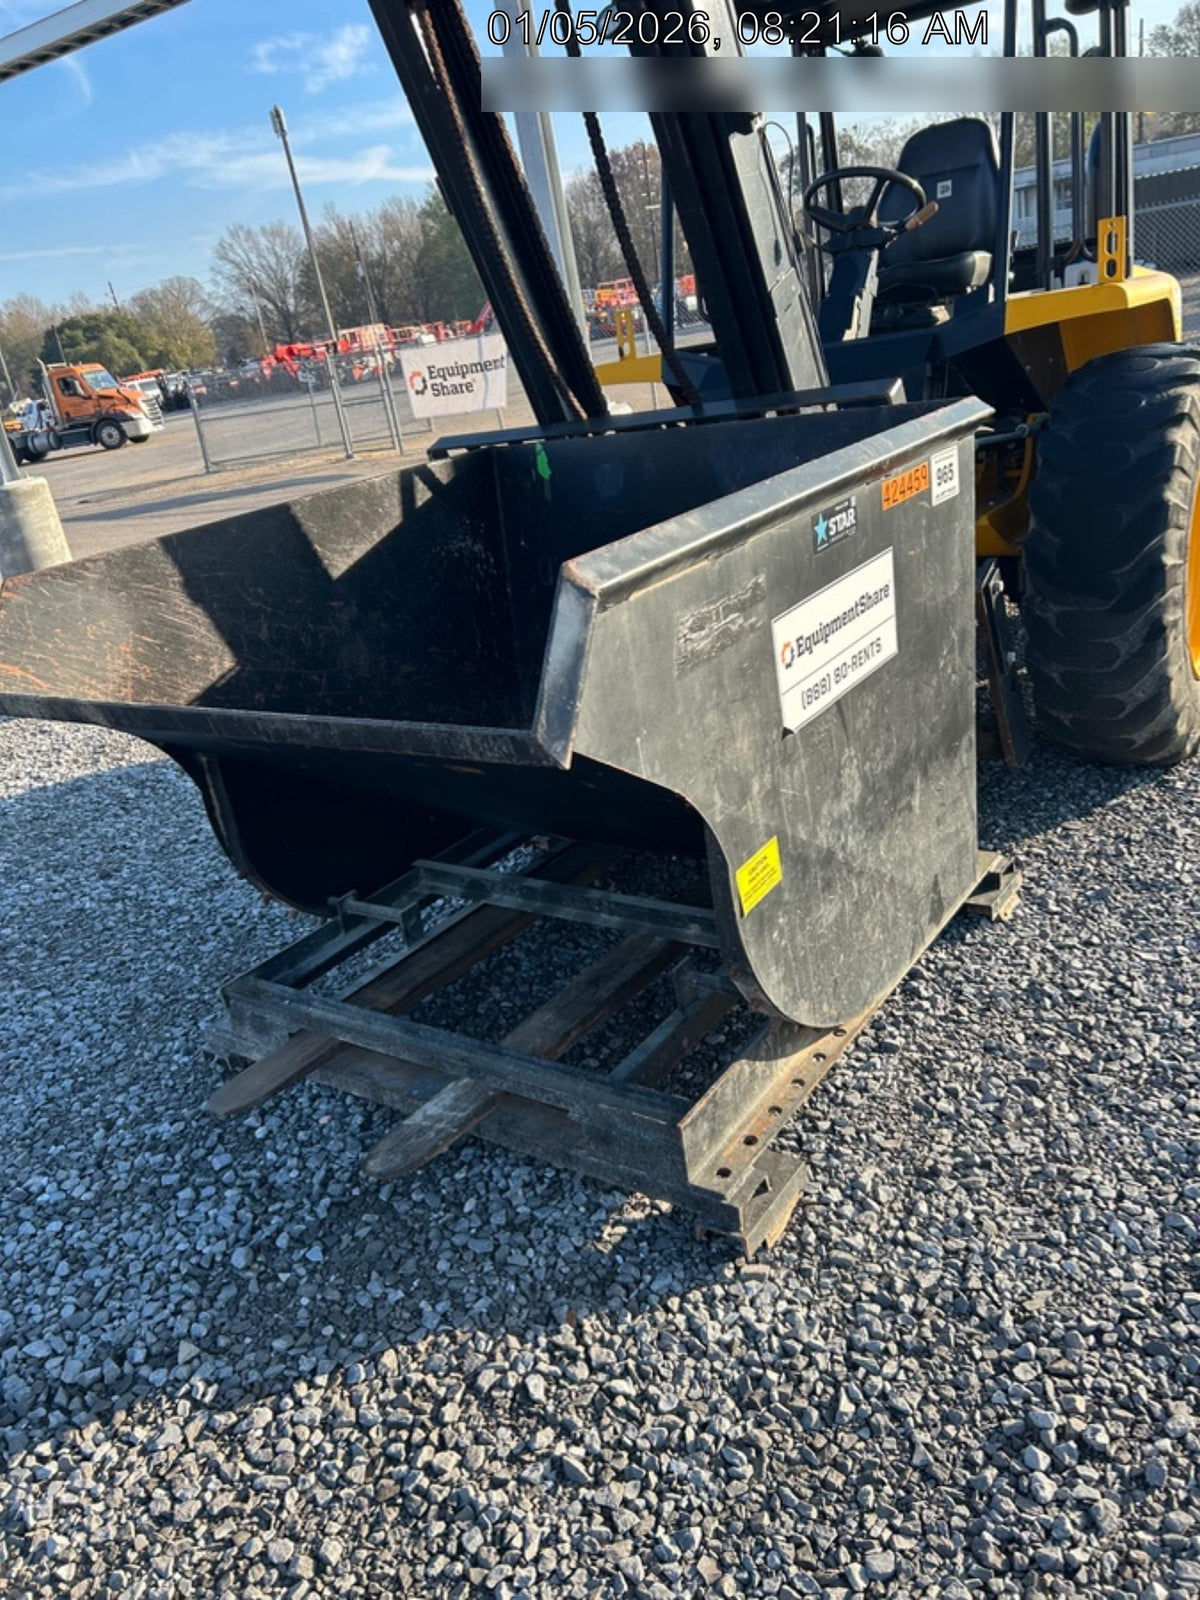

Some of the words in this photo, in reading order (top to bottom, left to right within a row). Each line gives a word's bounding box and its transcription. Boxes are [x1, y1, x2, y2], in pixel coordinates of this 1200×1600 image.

[427, 355, 505, 381] Equipment
[431, 381, 474, 397] Share
[883, 464, 928, 505] 424459
[936, 462, 954, 487] 965
[829, 508, 856, 536] STAR
[796, 584, 890, 658] EquipmentShare
[801, 673, 832, 710] (888)
